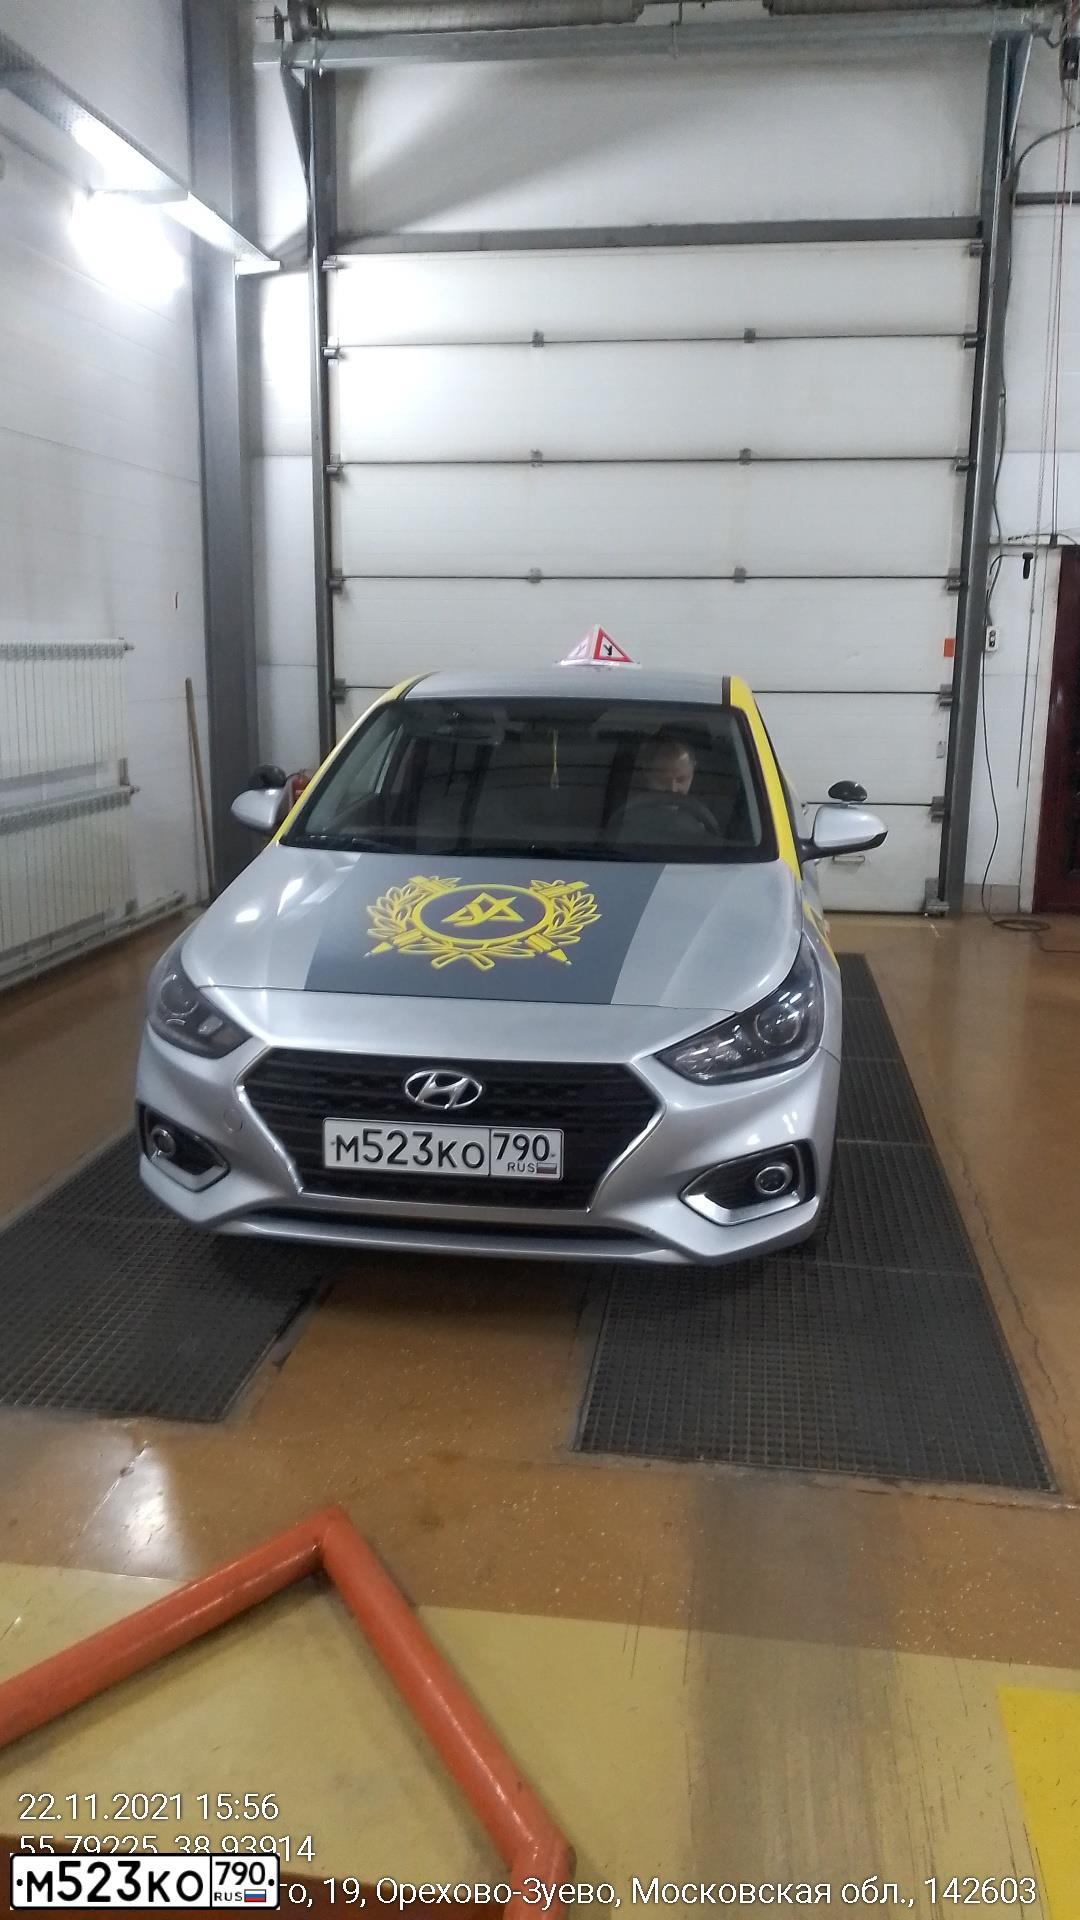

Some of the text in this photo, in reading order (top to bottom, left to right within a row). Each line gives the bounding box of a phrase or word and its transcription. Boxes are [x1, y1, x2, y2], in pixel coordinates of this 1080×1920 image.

[335, 1128, 550, 1169] М523КО 790
[507, 1162, 536, 1173] RUS
